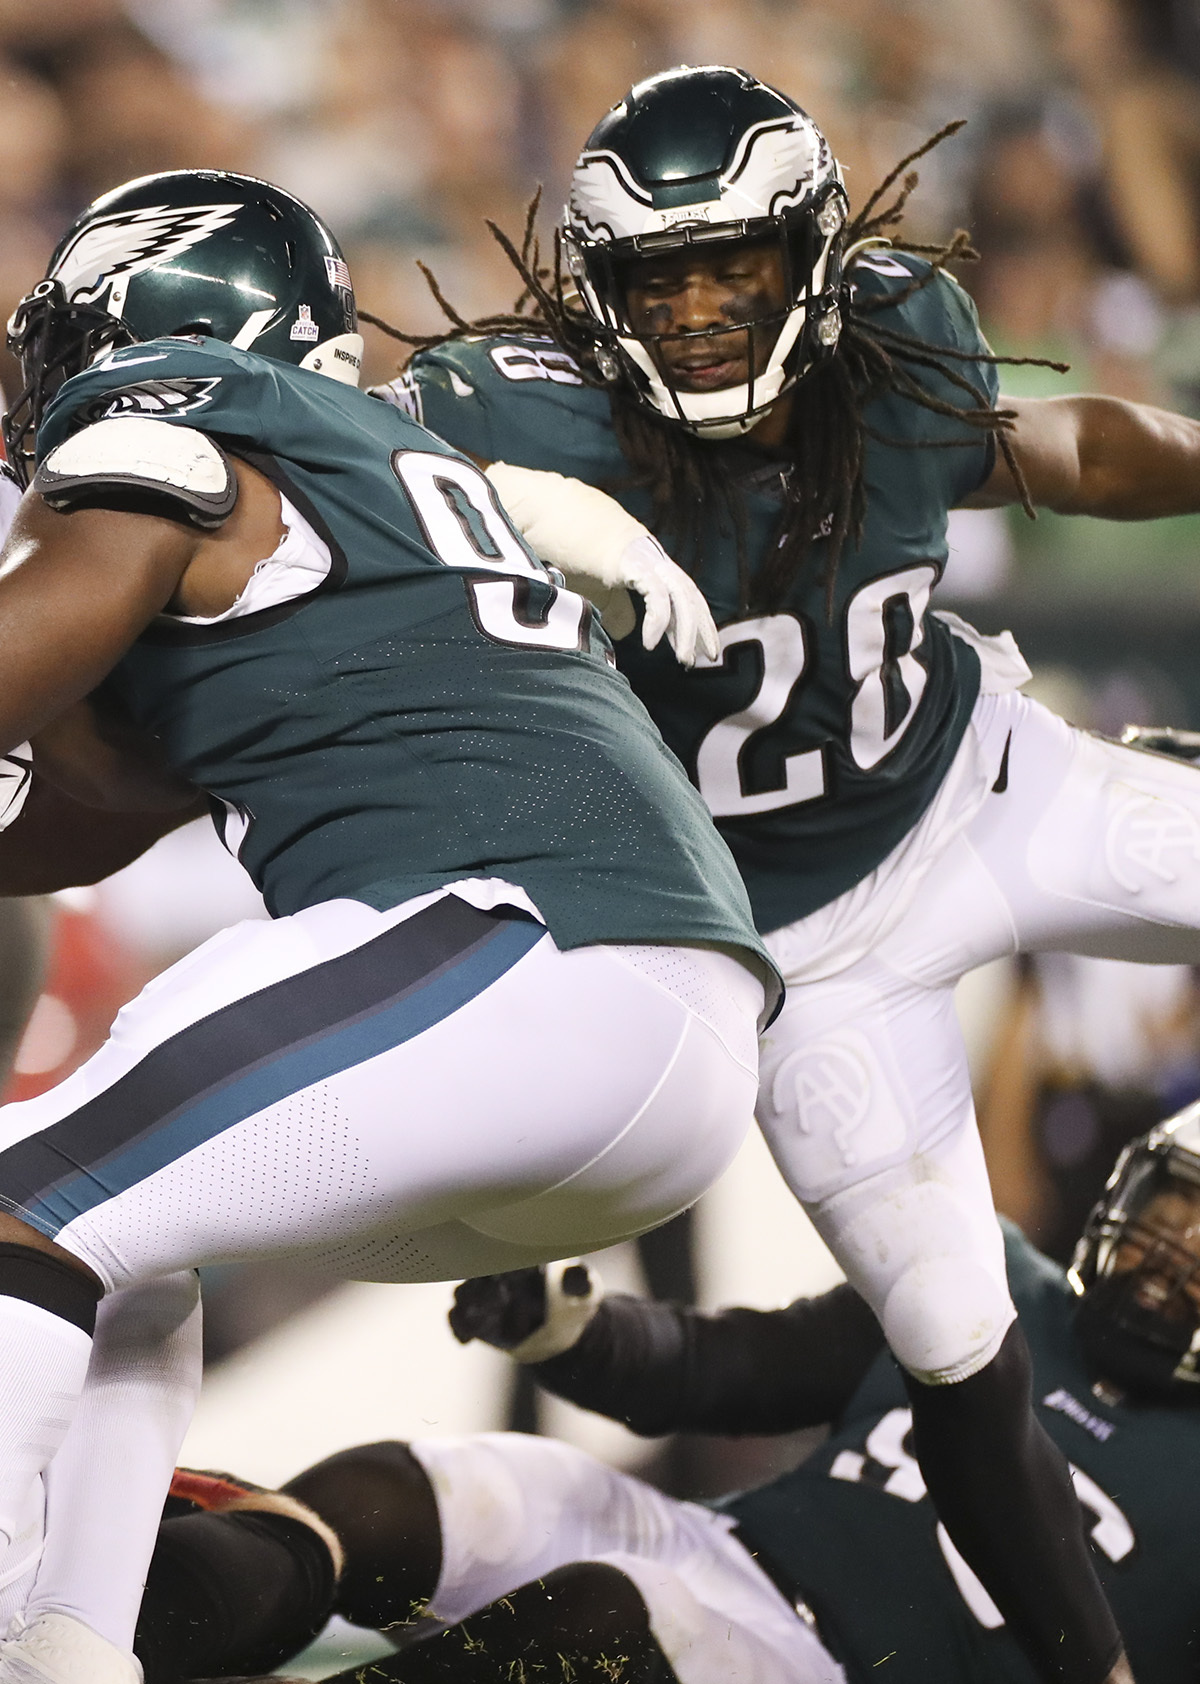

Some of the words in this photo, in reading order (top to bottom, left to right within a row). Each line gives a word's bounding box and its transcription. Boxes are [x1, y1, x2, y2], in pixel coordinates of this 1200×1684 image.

[292, 326, 318, 336] CATCH
[333, 347, 357, 367] INSPIRE
[388, 449, 617, 669] 9
[686, 560, 940, 819] 28
